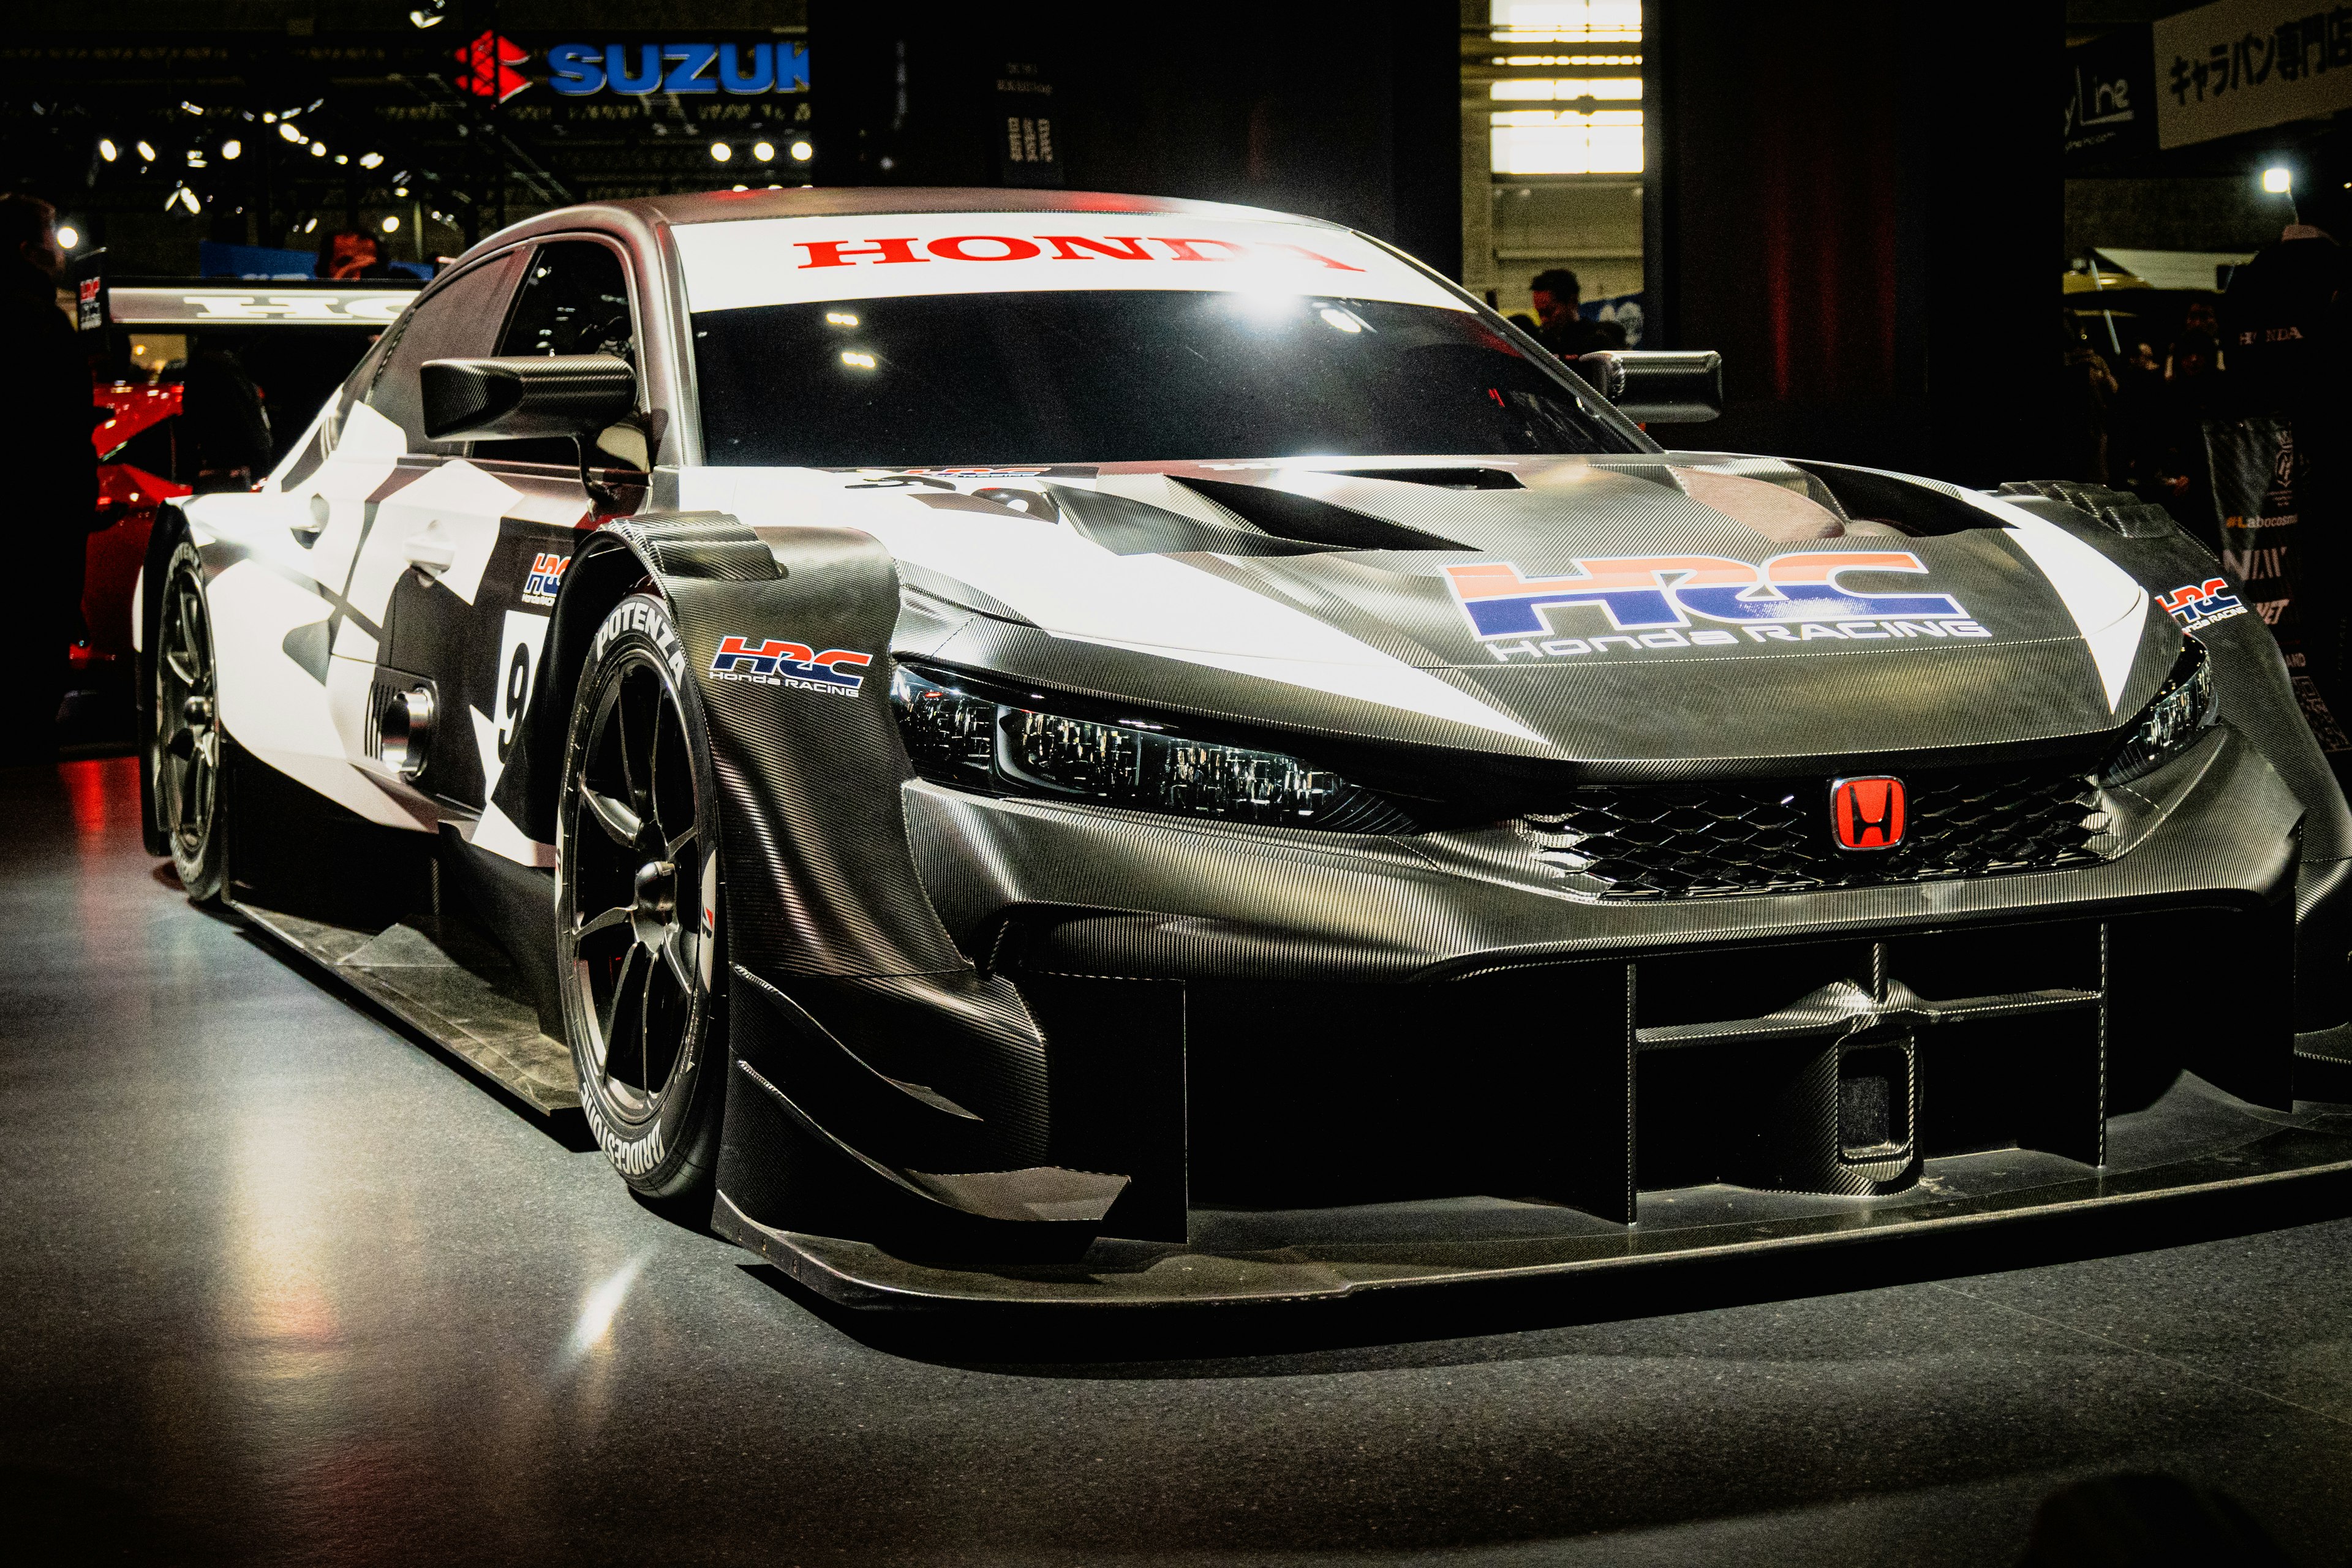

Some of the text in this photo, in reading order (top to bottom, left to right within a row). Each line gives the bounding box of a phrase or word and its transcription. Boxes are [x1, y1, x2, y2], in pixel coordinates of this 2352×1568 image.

[2238, 325, 2305, 347] HNDA
[1439, 550, 1972, 643] HRC
[2154, 577, 2242, 623] HRC
[2209, 606, 2248, 624] RACING
[597, 602, 686, 691] POTENZA
[709, 635, 873, 689] HRC
[1485, 619, 1993, 662] Honda RACING
[498, 642, 530, 764] 9
[709, 671, 859, 698] Honda RACING
